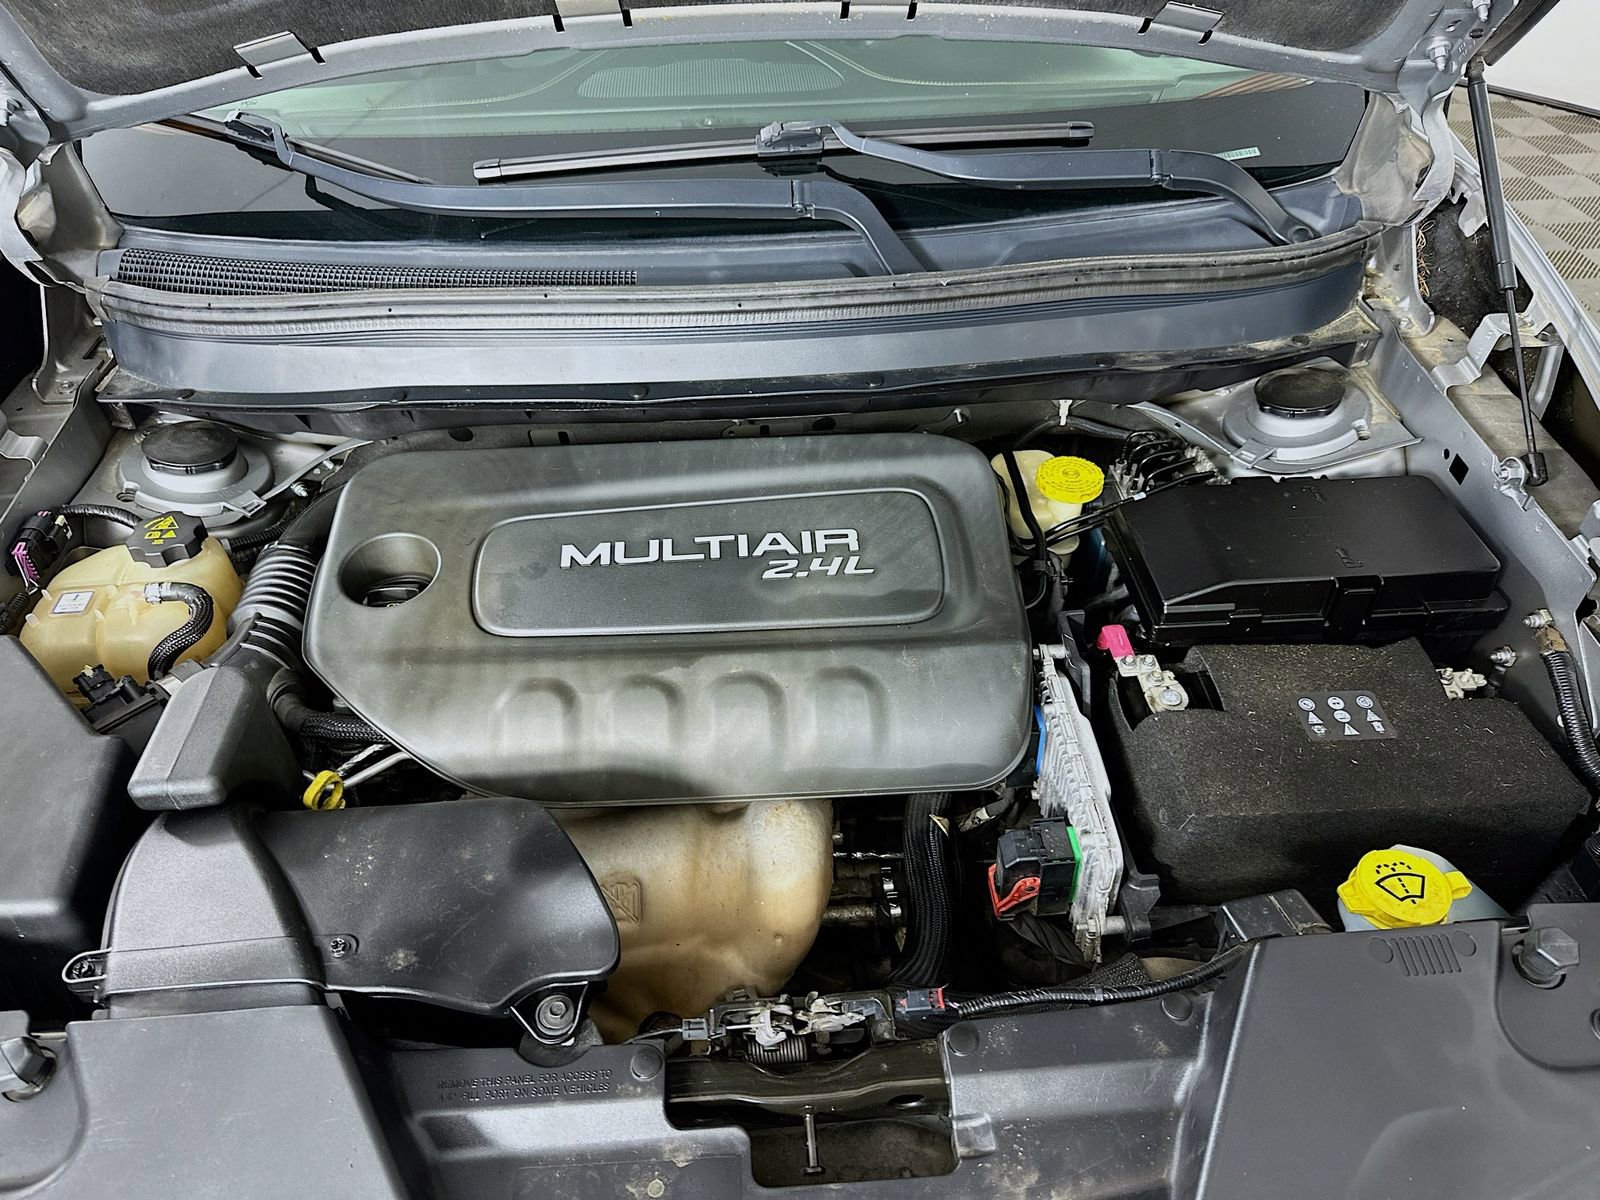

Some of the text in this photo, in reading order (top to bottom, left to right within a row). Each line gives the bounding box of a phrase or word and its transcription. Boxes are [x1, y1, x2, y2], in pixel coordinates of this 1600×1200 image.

[560, 528, 861, 568] MULTIAIR
[761, 555, 876, 579] 2.4L
[480, 1077, 503, 1087] THIS
[504, 1075, 535, 1086] PANEL
[537, 1073, 558, 1083] FOR
[559, 1070, 598, 1082] ACCESS
[599, 1069, 612, 1080] TO
[484, 1089, 511, 1100] PORT
[514, 1087, 529, 1098] ON
[531, 1086, 560, 1098] SOME
[563, 1082, 611, 1095] VEHICLES
